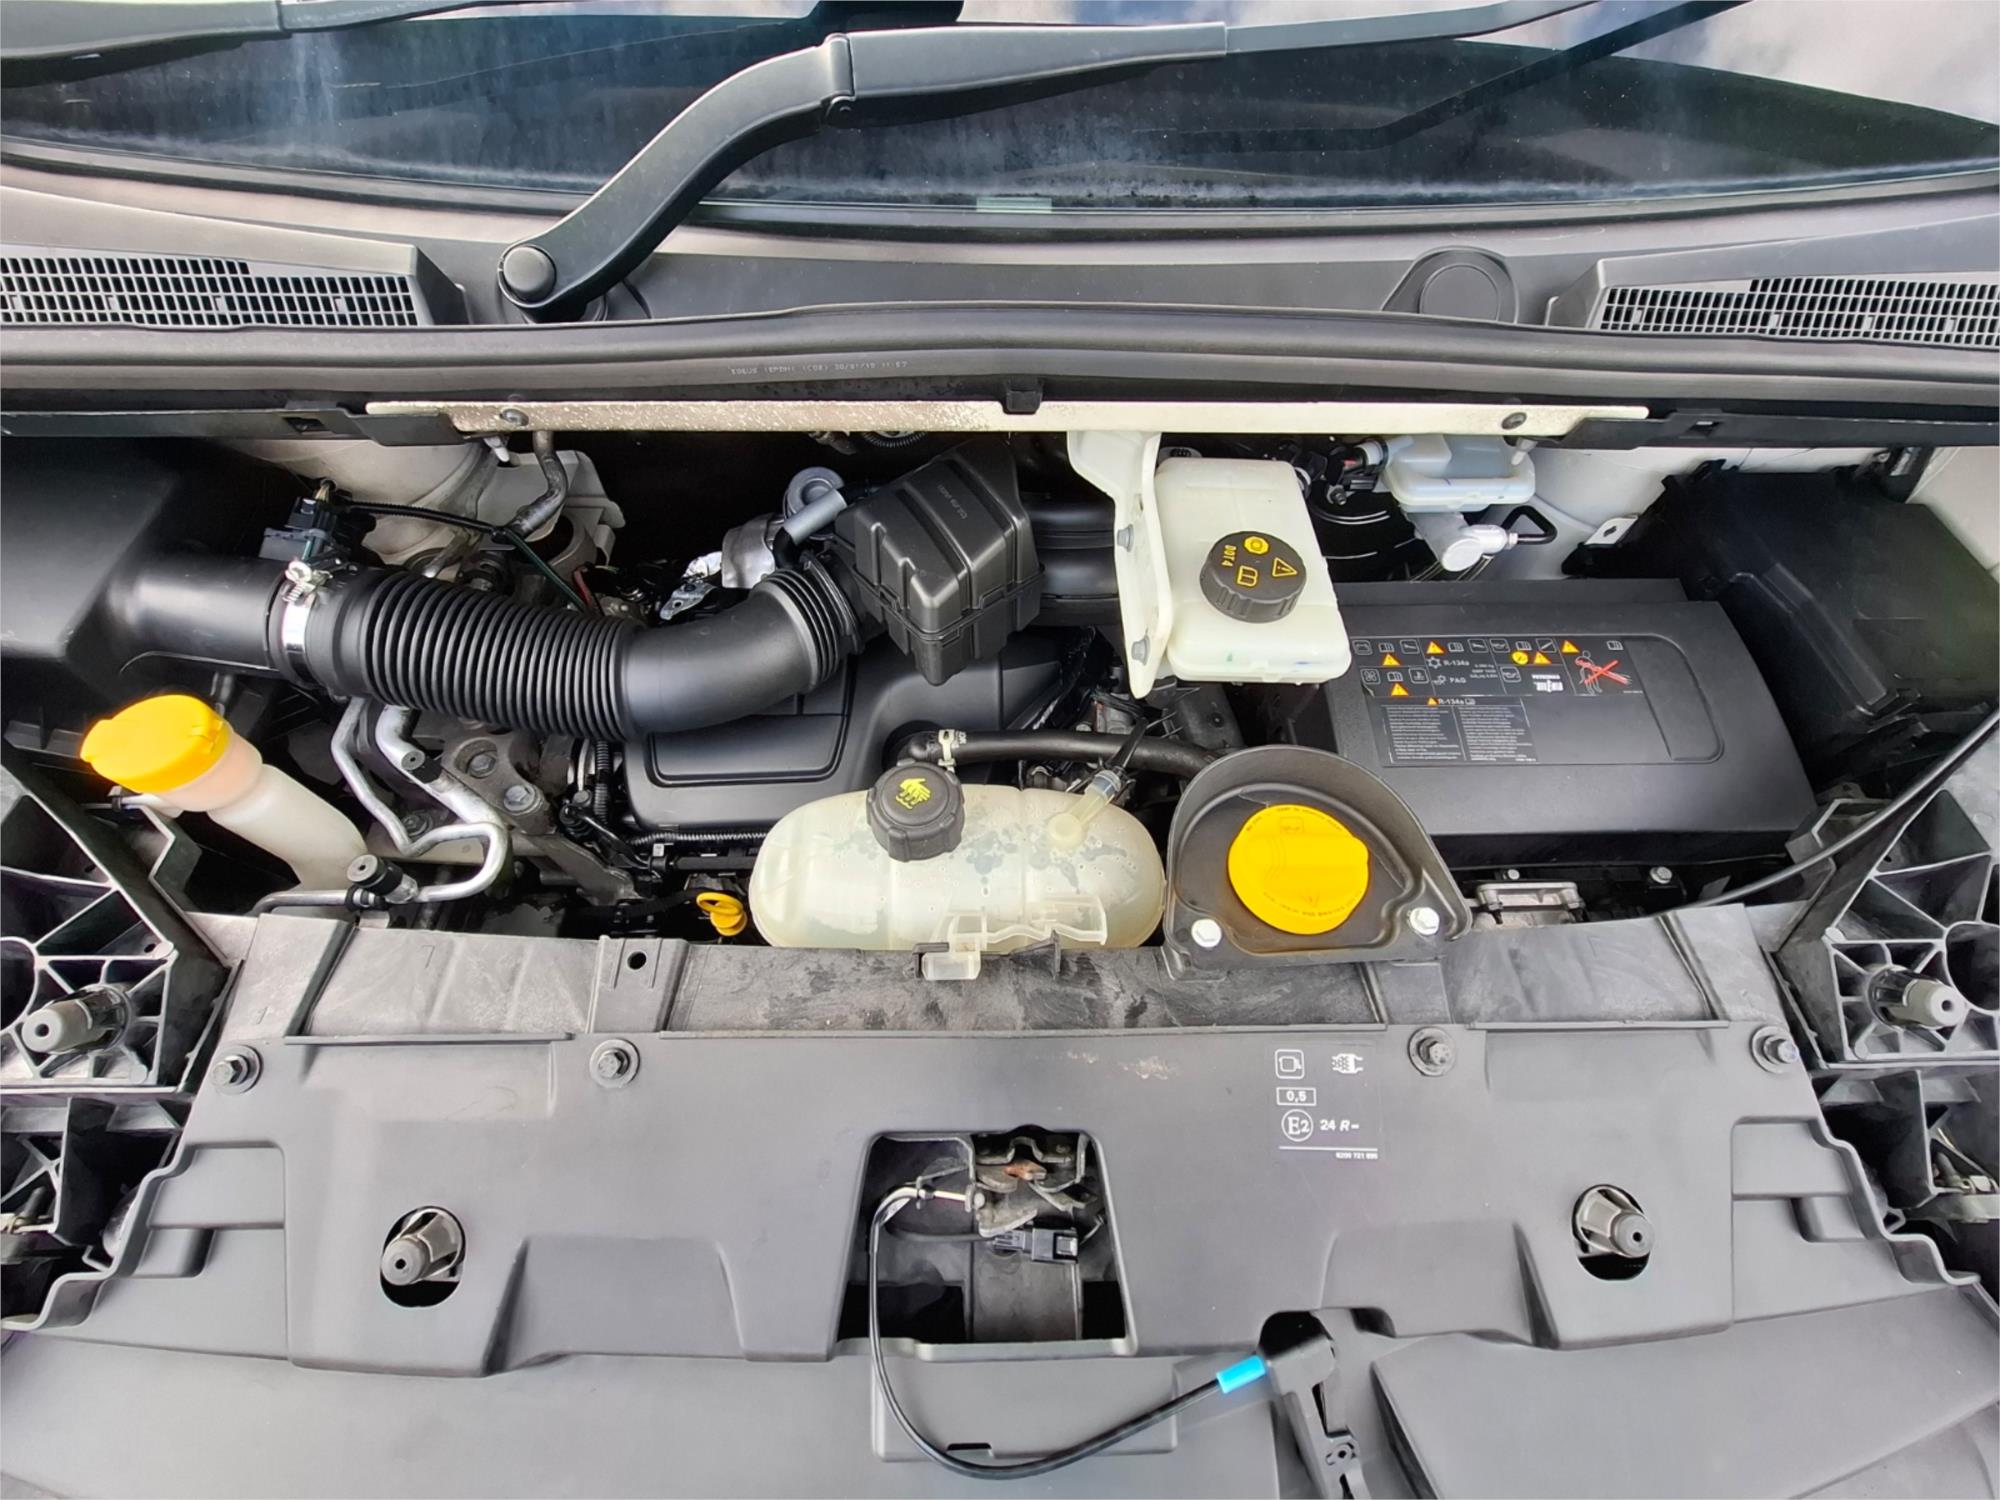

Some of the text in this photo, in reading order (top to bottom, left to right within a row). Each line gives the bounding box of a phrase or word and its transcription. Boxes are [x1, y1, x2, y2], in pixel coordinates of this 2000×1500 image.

[1442, 659, 1470, 667] R-134a
[1438, 698, 1464, 706] R-134a
[1286, 1090, 1307, 1103] 0,5
[1287, 1116, 1310, 1136] E2
[1319, 1119, 1336, 1131] 24
